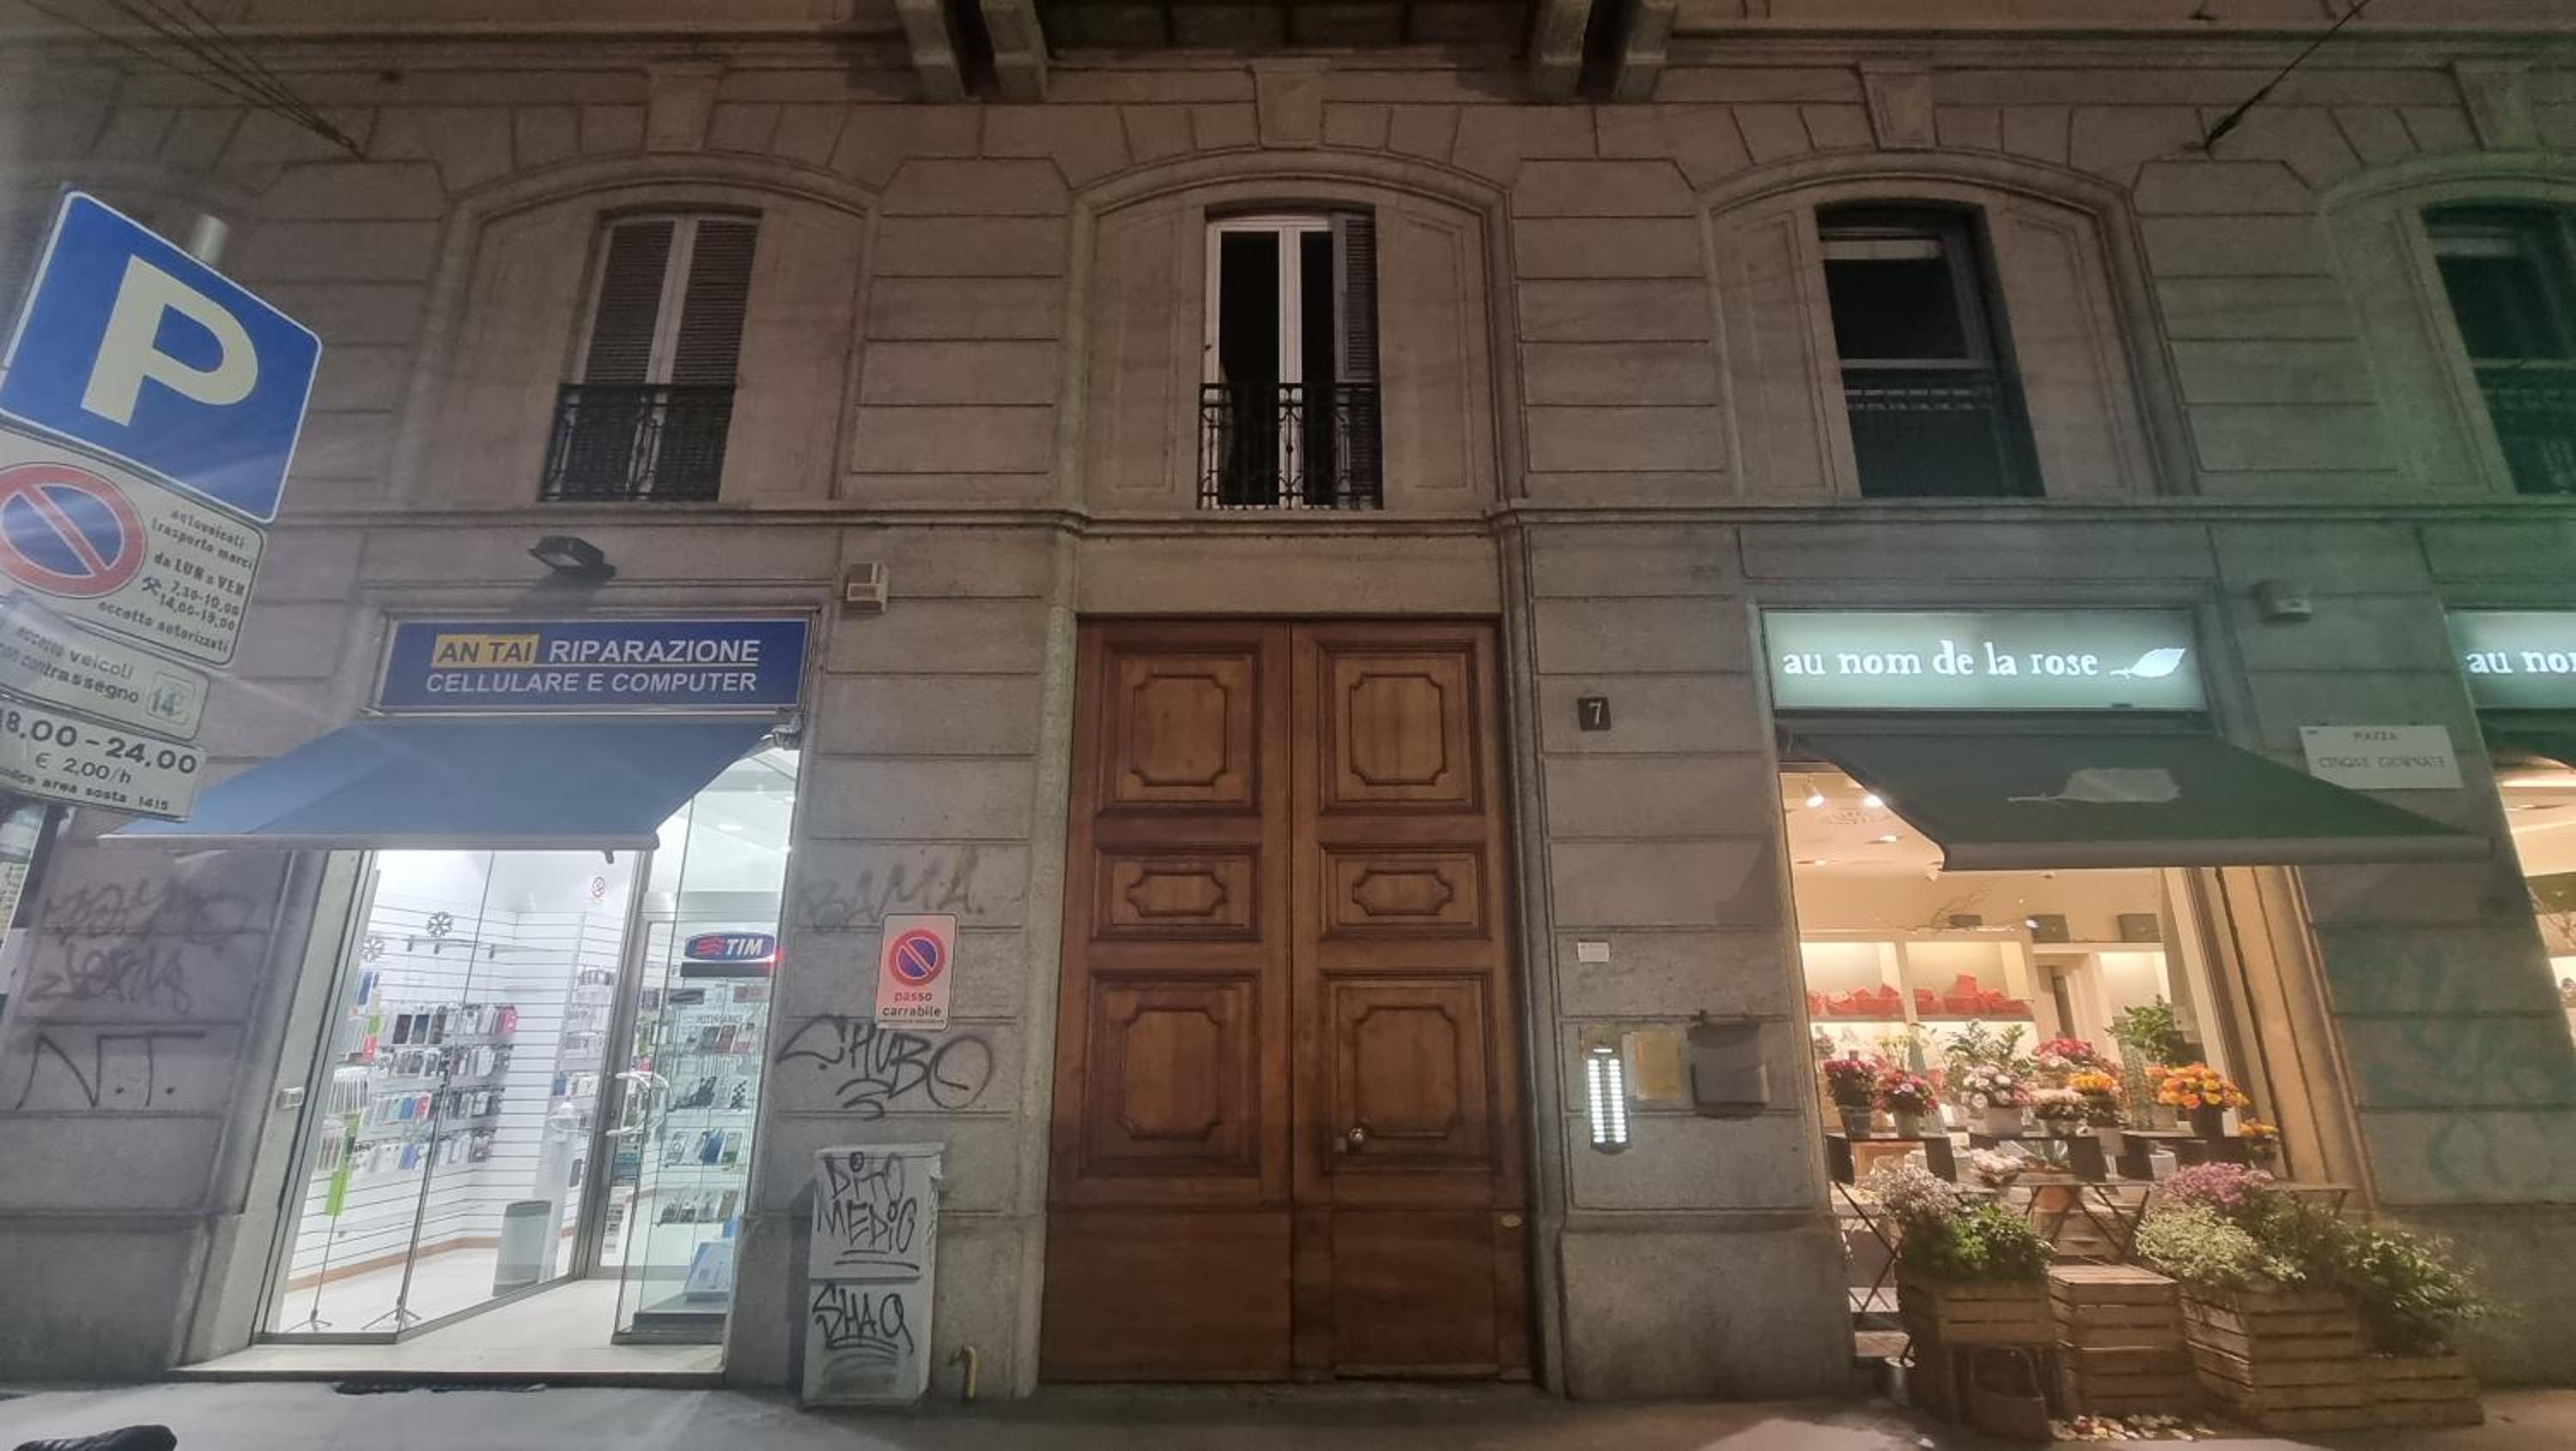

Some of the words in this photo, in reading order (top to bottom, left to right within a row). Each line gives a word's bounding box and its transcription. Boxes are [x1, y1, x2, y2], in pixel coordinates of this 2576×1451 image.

[81, 254, 258, 427] P
[155, 551, 170, 568] da
[174, 559, 204, 580] LUN
[218, 576, 245, 598] VEN
[437, 642, 481, 663] AN
[489, 641, 533, 663] TAI
[549, 640, 761, 663] RIPARAZIONE
[1783, 653, 1826, 676] au
[1838, 653, 1923, 676] nom
[1932, 641, 1974, 676] de
[1984, 642, 2017, 676] la
[2030, 653, 2099, 676] rose
[2466, 652, 2513, 673] au
[2521, 651, 2576, 673] no
[70, 649, 133, 680] veicoli
[427, 673, 579, 693] CELLULARE
[587, 673, 603, 692] E
[611, 672, 756, 692] COMPUTER
[1589, 700, 1603, 726] 7
[35, 753, 51, 770] €
[41, 780, 77, 794] area
[86, 787, 127, 803] sosta
[726, 938, 763, 956] TIM
[894, 992, 933, 1003] passo
[882, 1006, 942, 1017] carrabile
